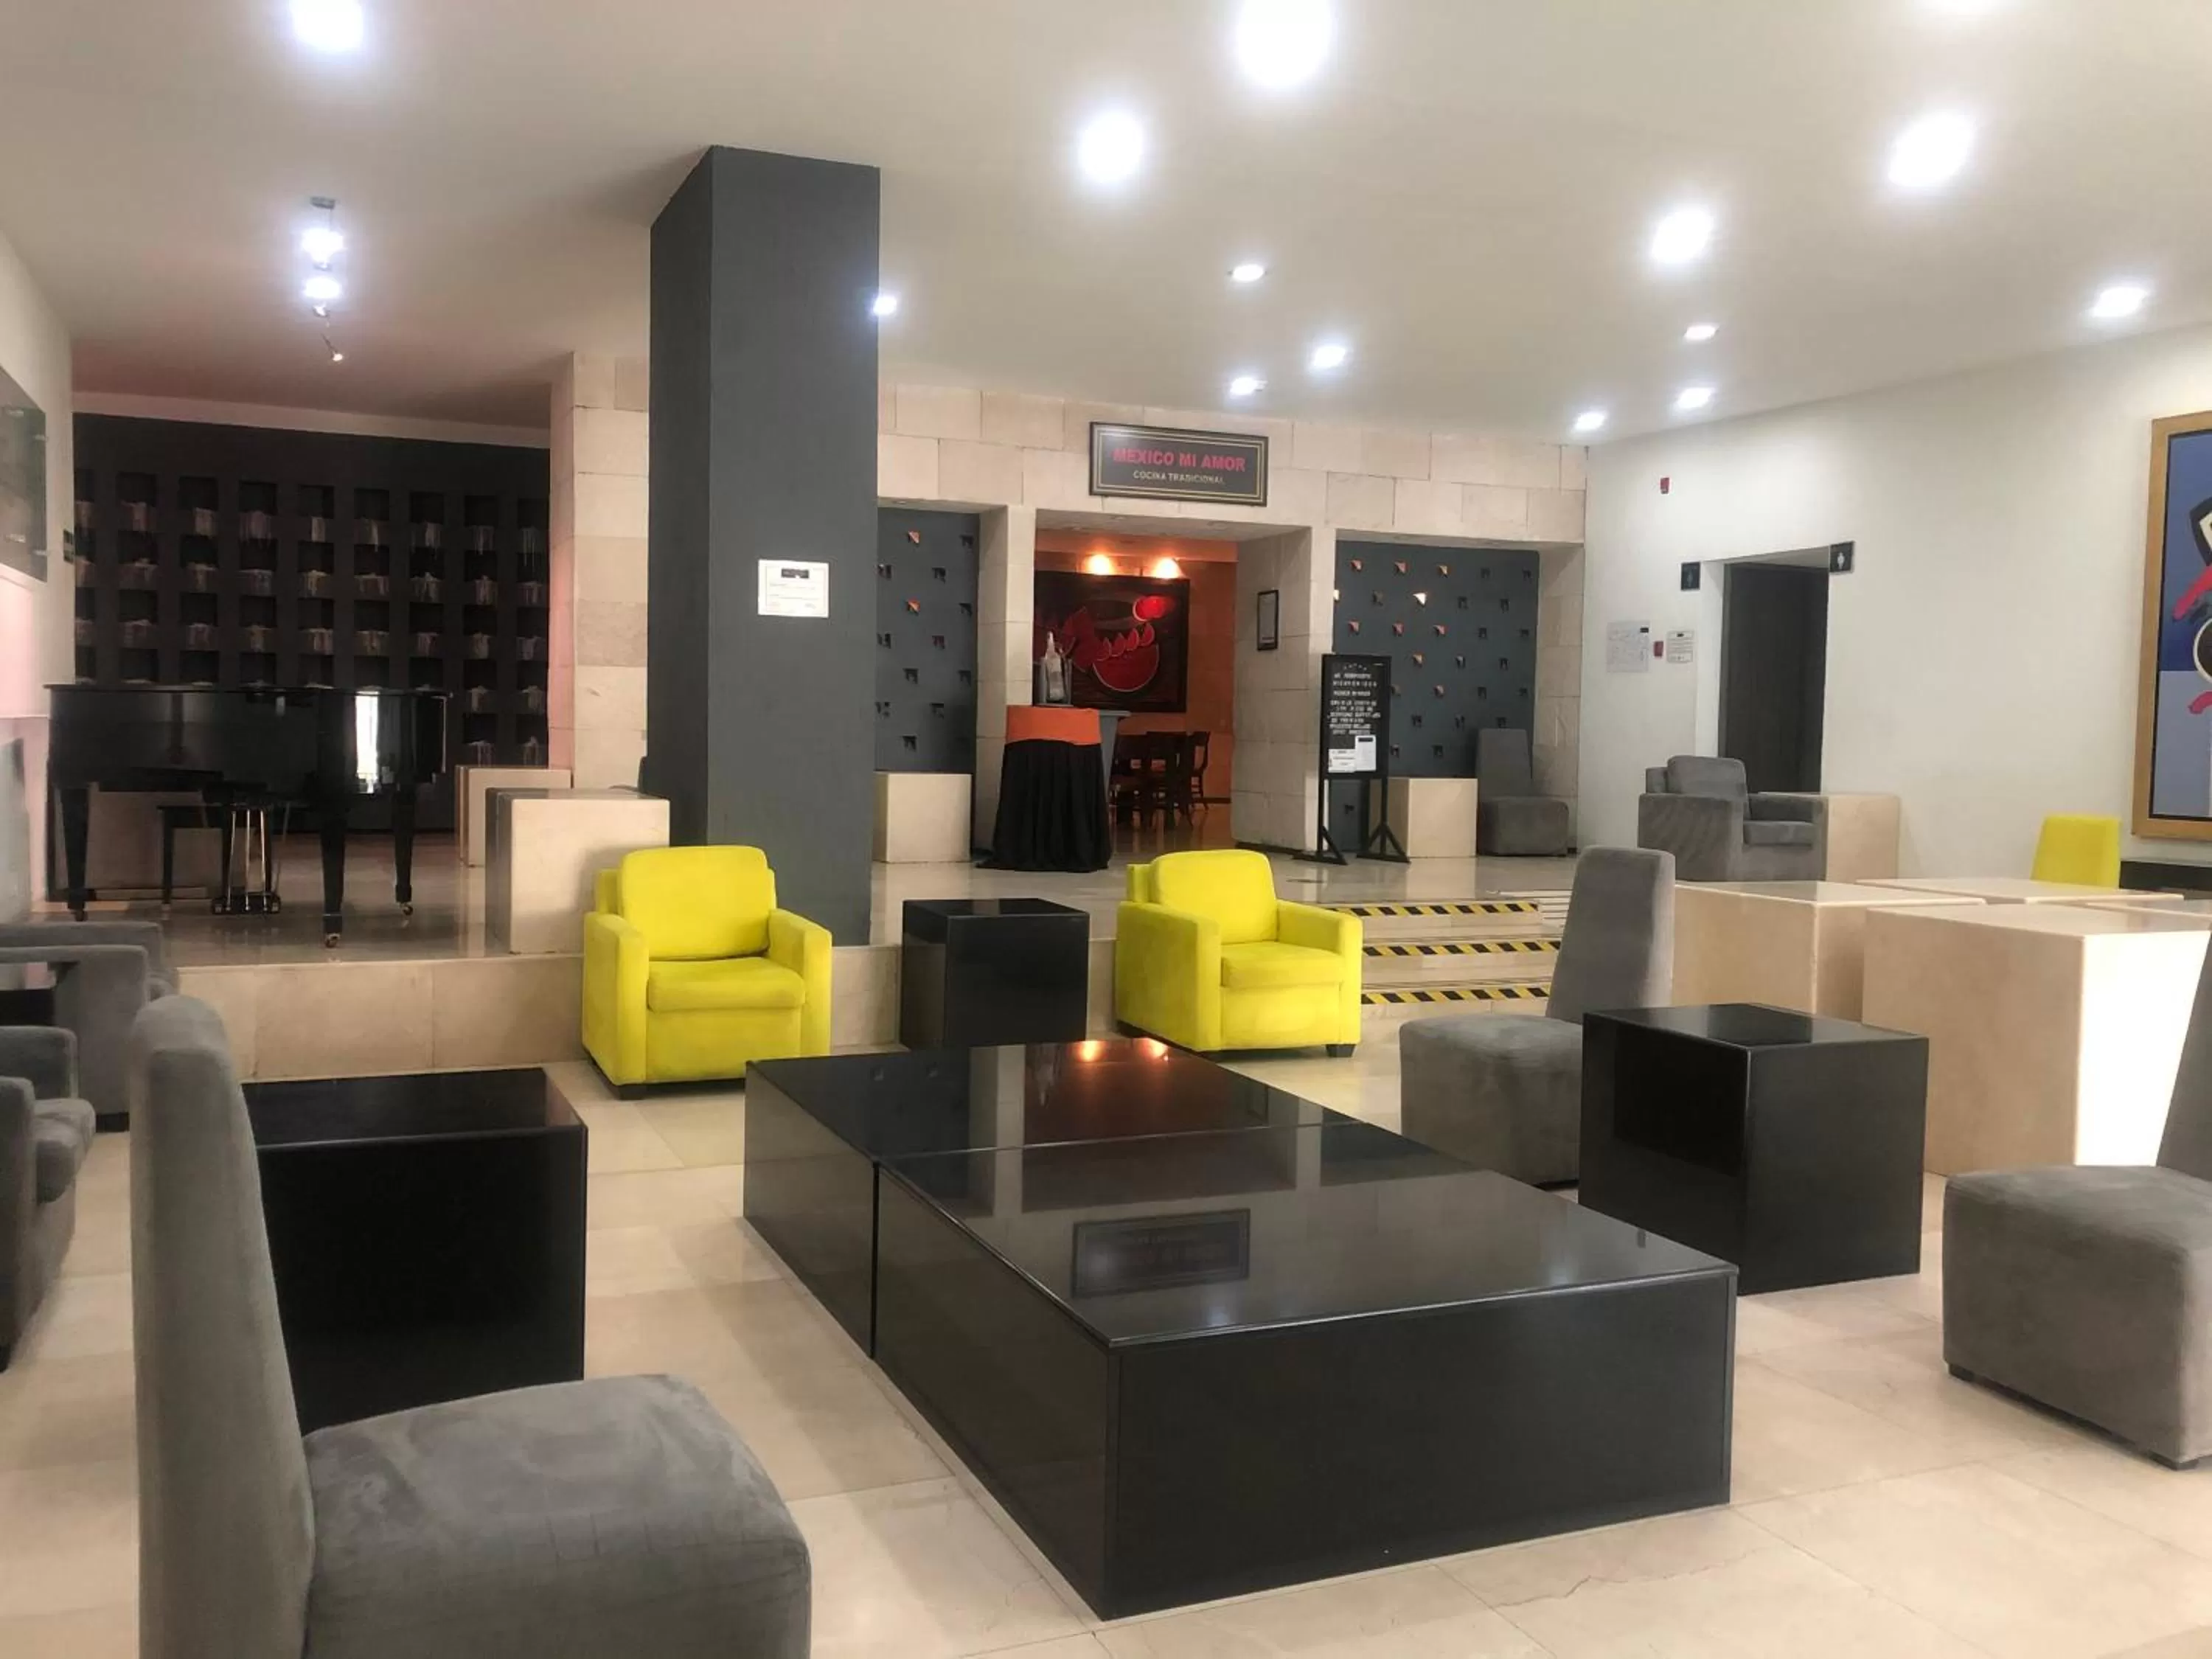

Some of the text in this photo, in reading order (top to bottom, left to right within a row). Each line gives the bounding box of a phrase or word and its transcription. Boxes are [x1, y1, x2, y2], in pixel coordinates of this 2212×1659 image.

[1179, 452, 1197, 467] MI
[1200, 454, 1245, 472] AMOR
[1133, 470, 1225, 484] COCINA TRADICIONAL
